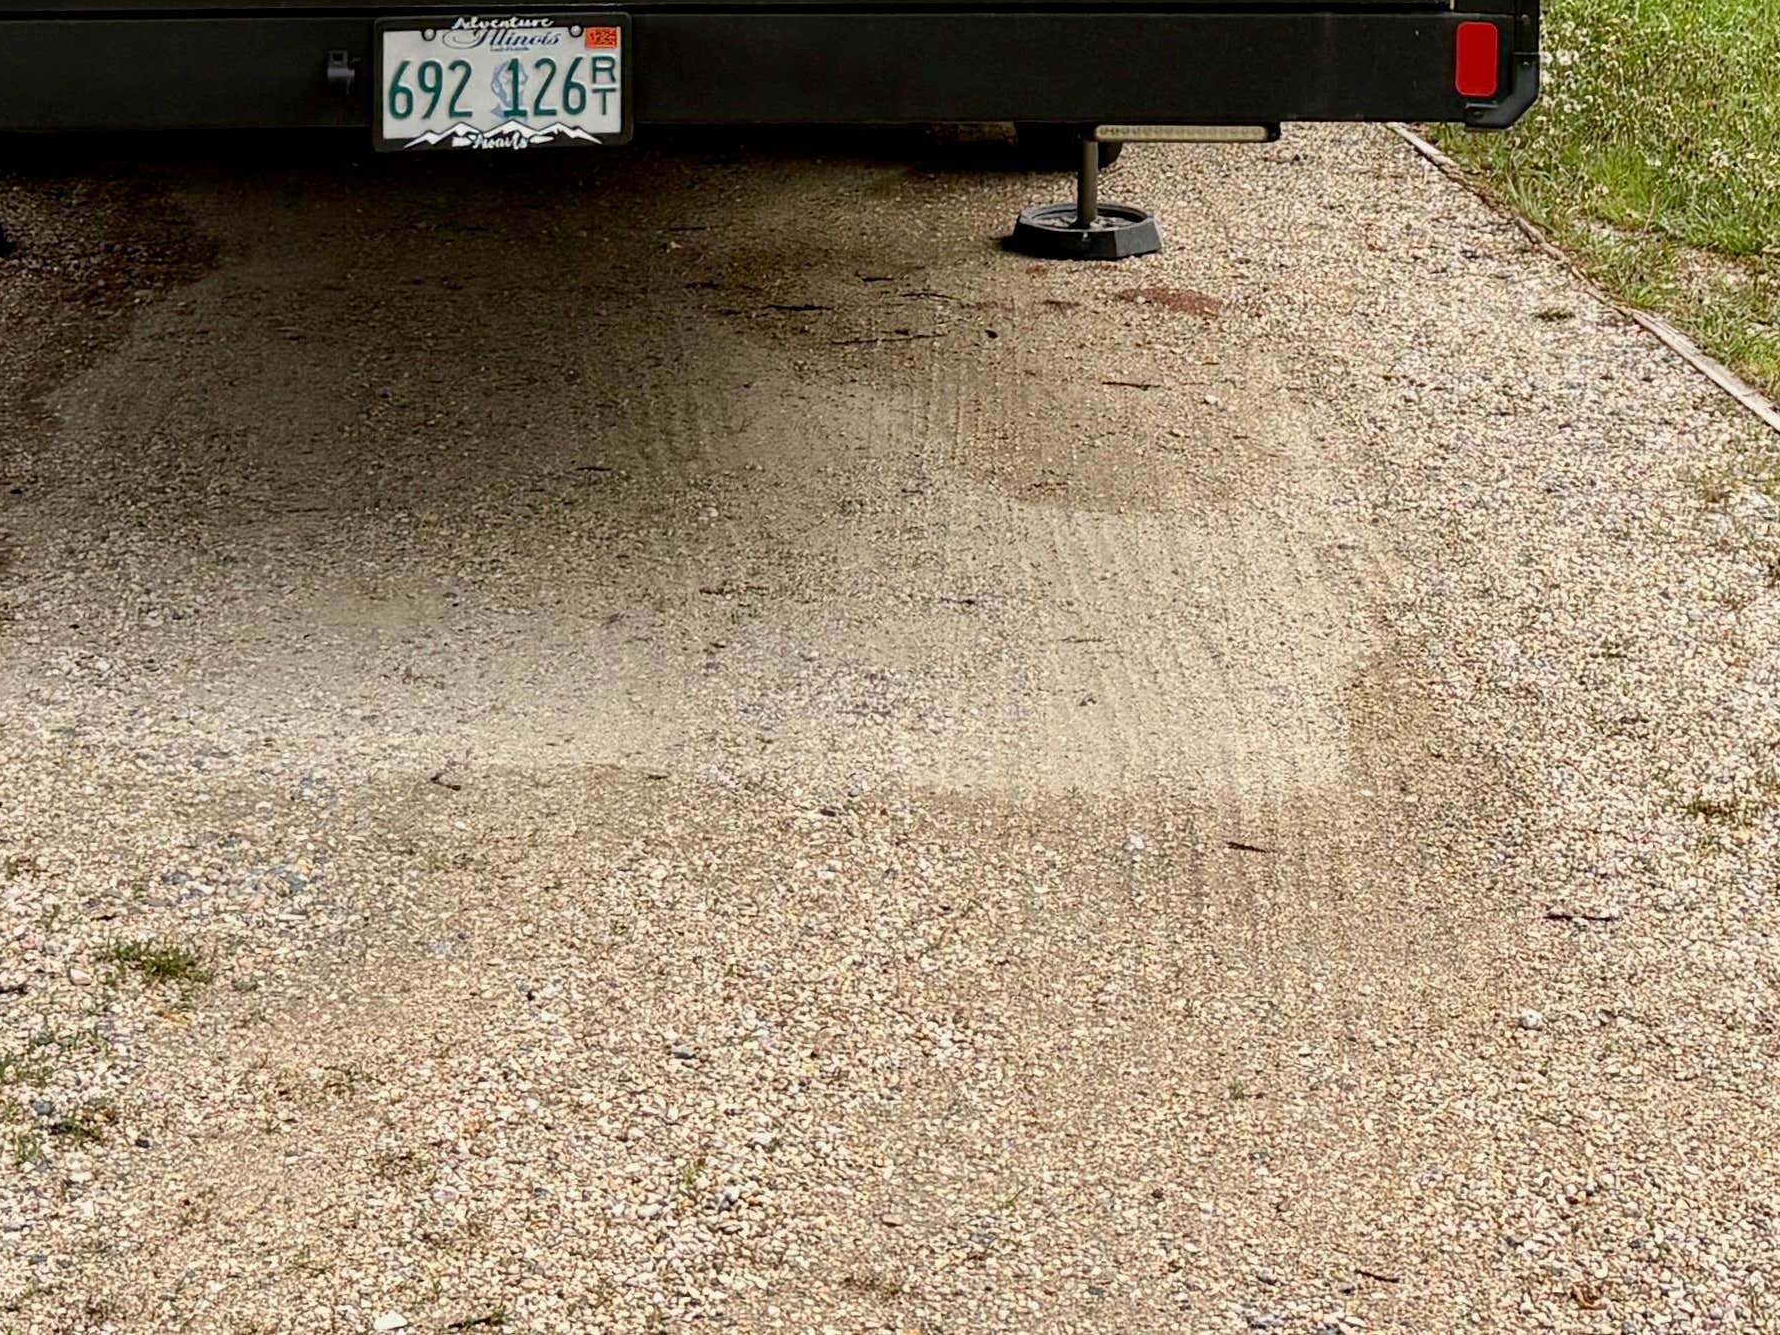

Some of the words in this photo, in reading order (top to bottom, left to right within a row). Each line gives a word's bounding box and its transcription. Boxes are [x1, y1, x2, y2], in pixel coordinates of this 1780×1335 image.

[451, 16, 554, 30] Adventure
[443, 29, 561, 49] Illinois
[388, 59, 473, 120] 692
[503, 56, 587, 117] 126
